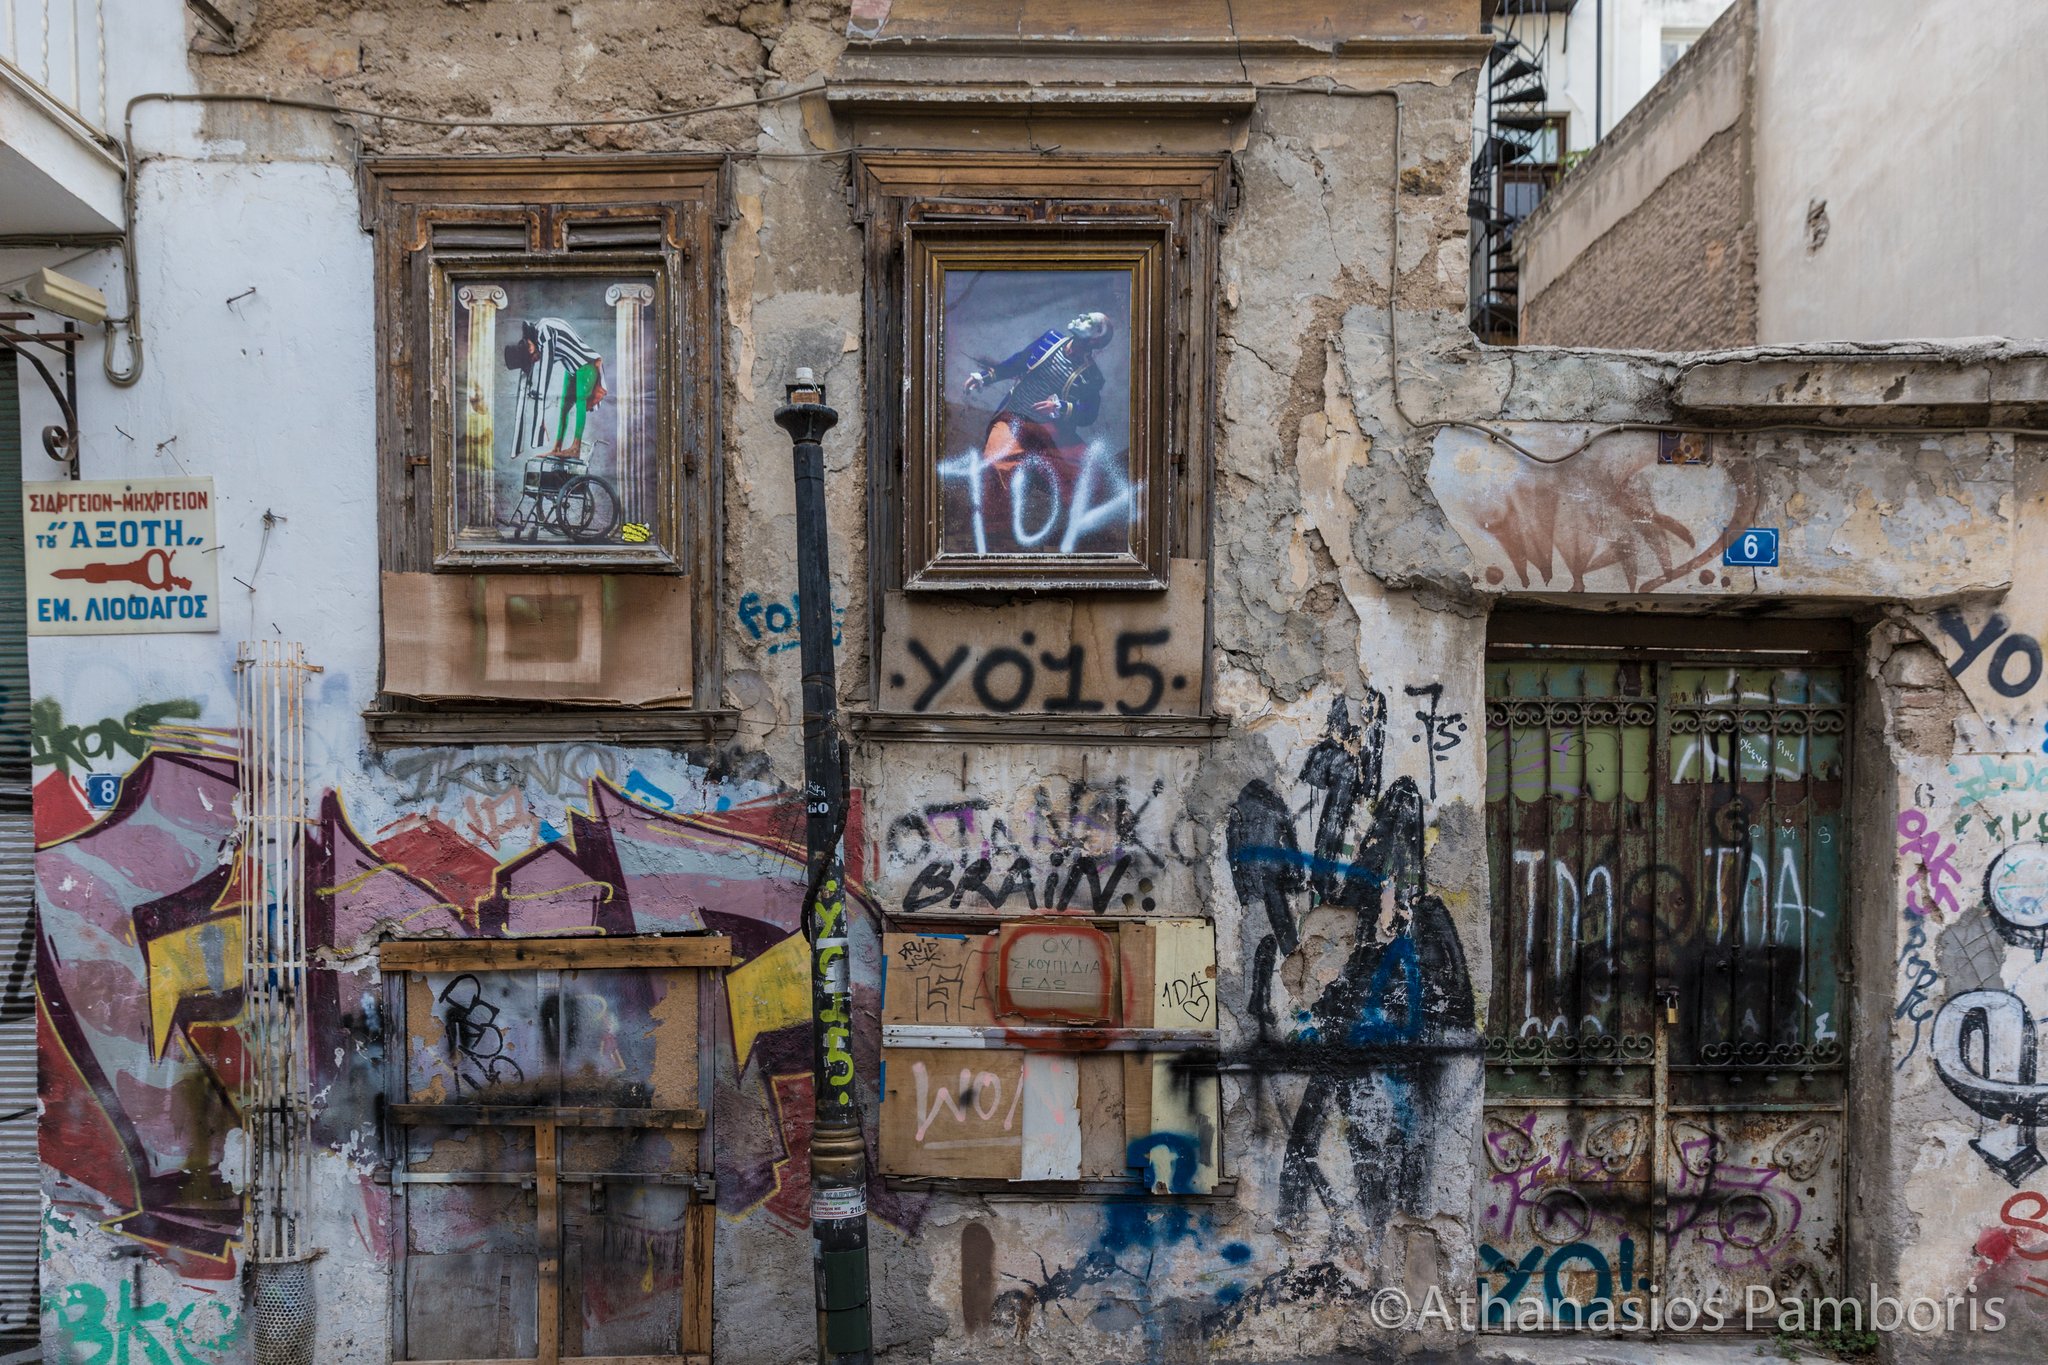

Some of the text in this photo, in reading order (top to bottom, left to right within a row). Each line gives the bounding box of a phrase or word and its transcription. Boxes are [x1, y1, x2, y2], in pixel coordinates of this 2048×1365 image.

[1743, 533, 1759, 561] 6
[37, 594, 208, 622] ΕΜ. ΛΙΟΦΑΓΟΣ
[101, 779, 116, 803] 8
[1011, 957, 1101, 975] ΣΚΟΥΠΙΔΙΑ
